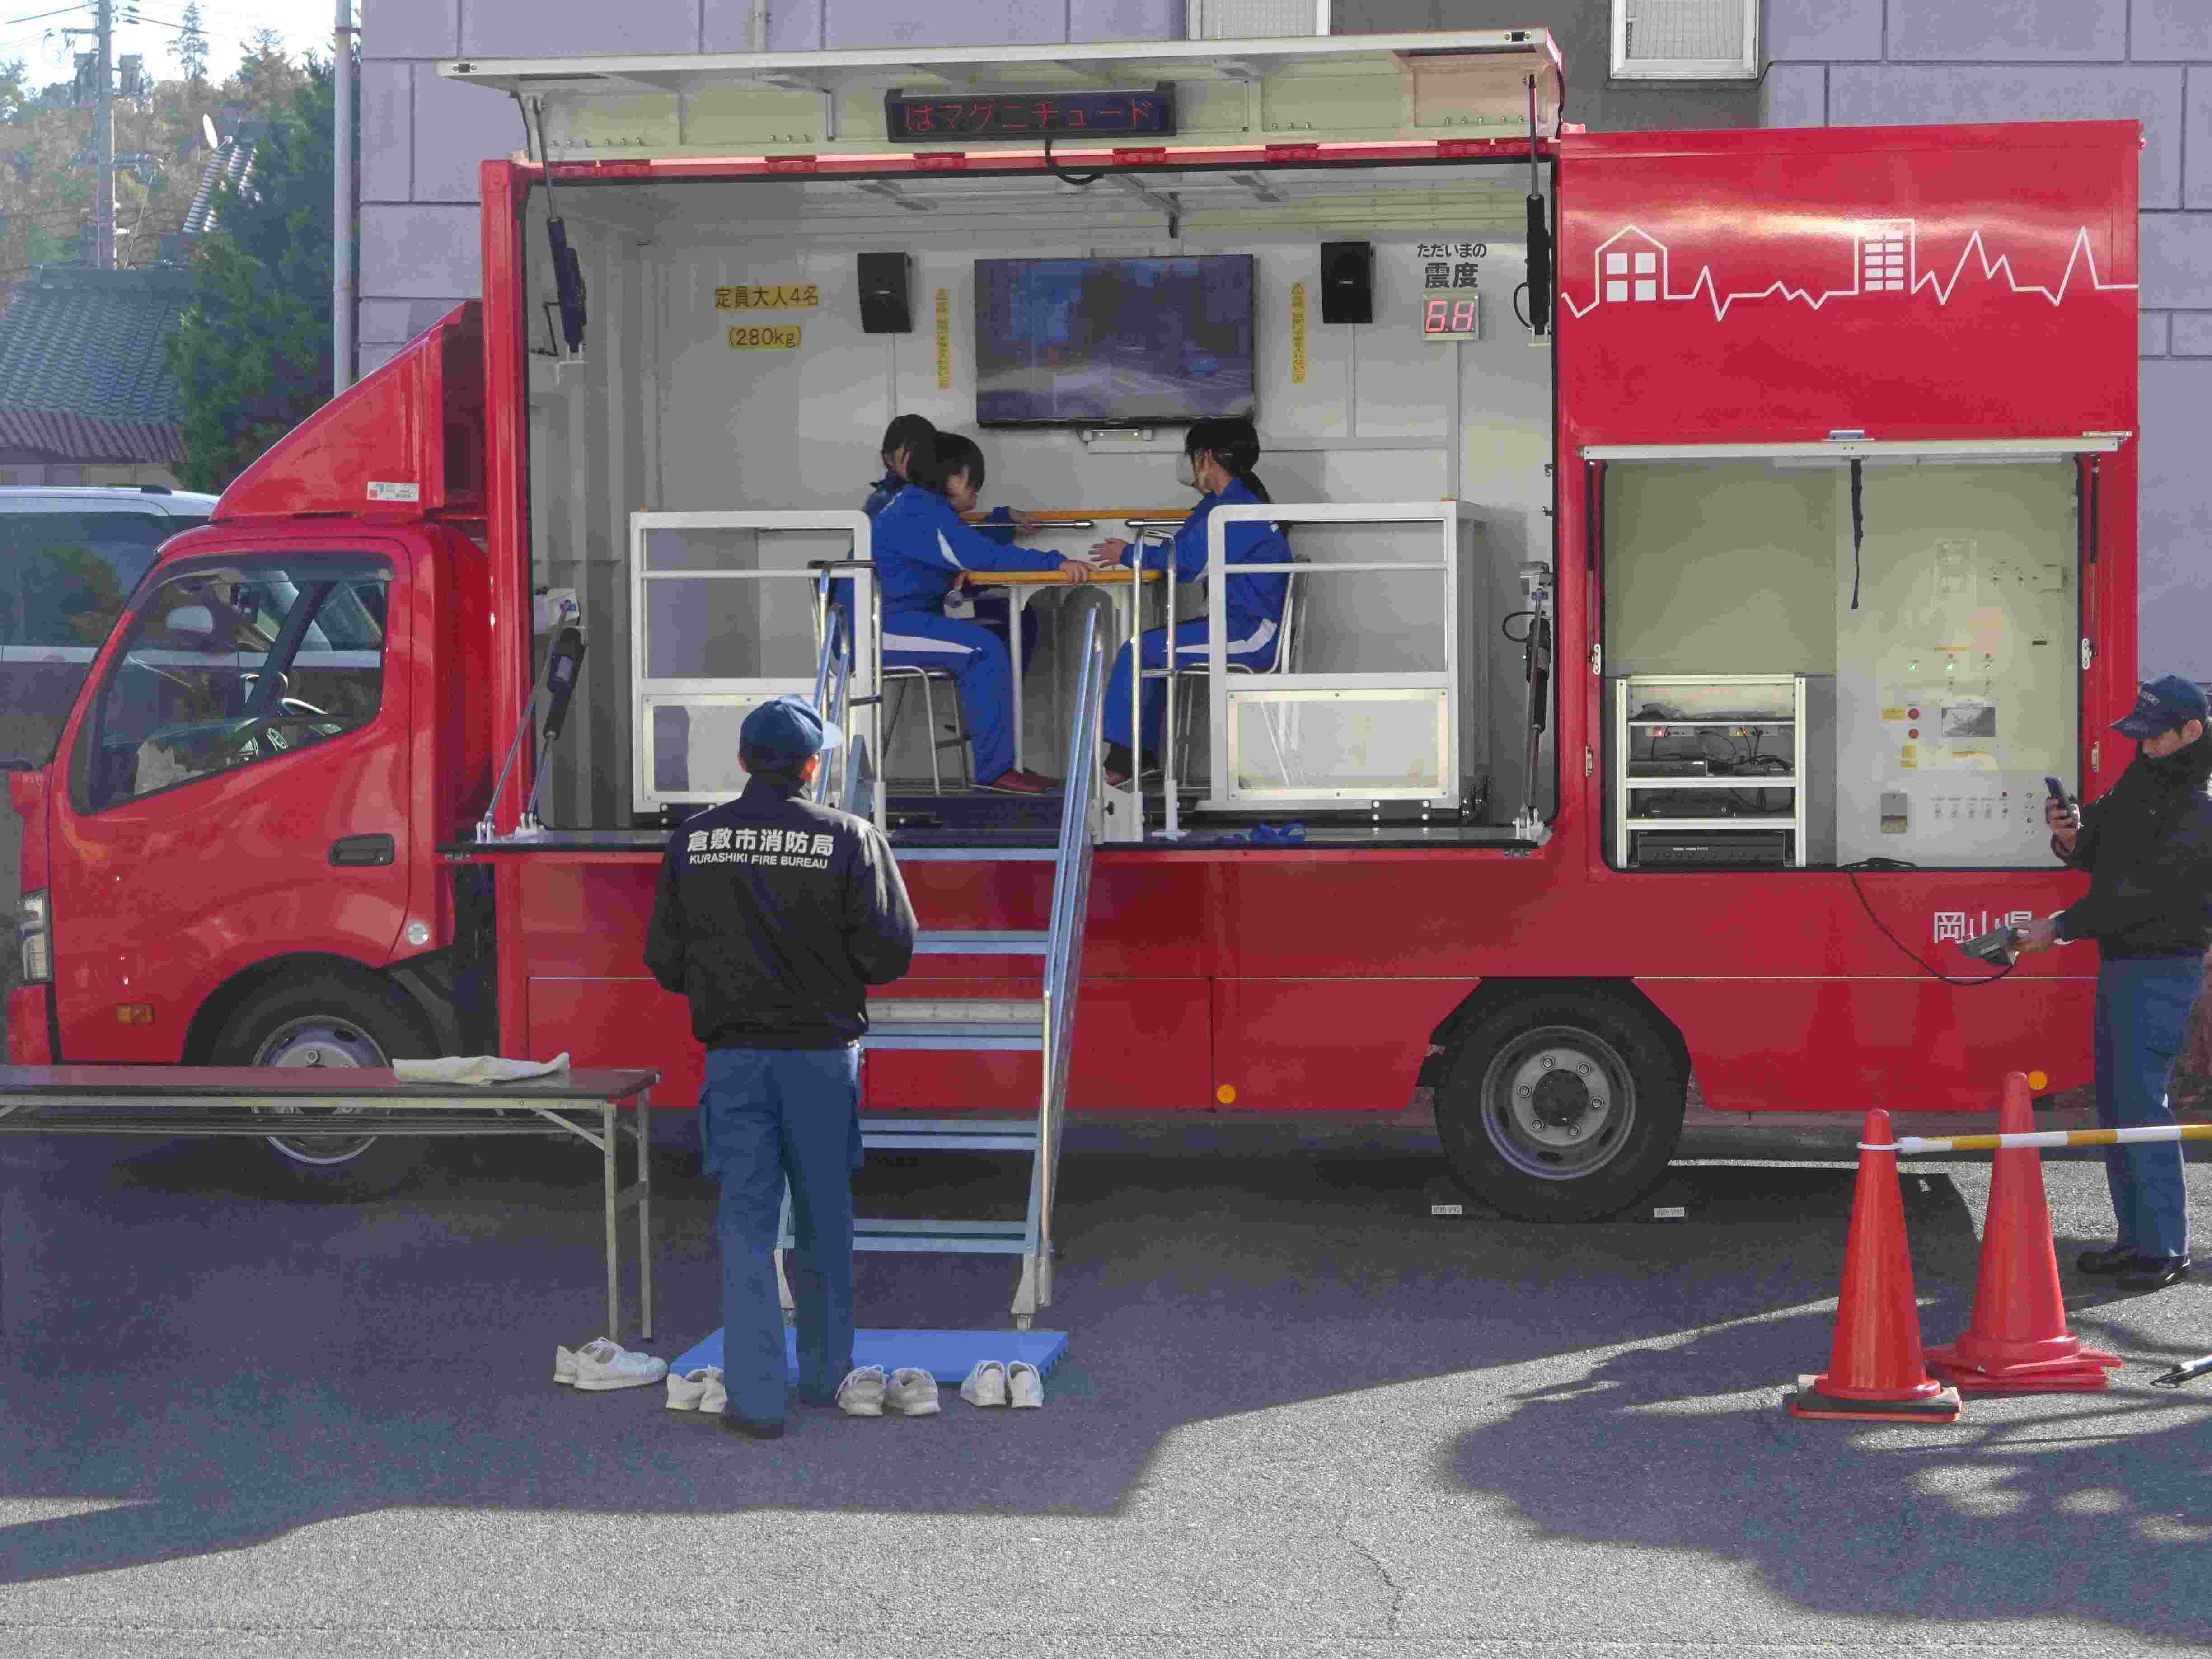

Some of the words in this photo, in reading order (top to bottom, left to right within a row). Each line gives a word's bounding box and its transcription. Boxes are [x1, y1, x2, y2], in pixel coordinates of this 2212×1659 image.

[905, 101, 1152, 130] はマグニチュード
[1417, 243, 1487, 258] ただいまの
[1425, 262, 1478, 288] 震度
[715, 285, 818, 307] 定員大人4名
[730, 325, 801, 347] (280kg)
[687, 828, 834, 856] 倉敷市消防局
[689, 852, 748, 864] KURASHIKI
[751, 855, 777, 866] FIRE
[781, 856, 828, 869] BUREAU
